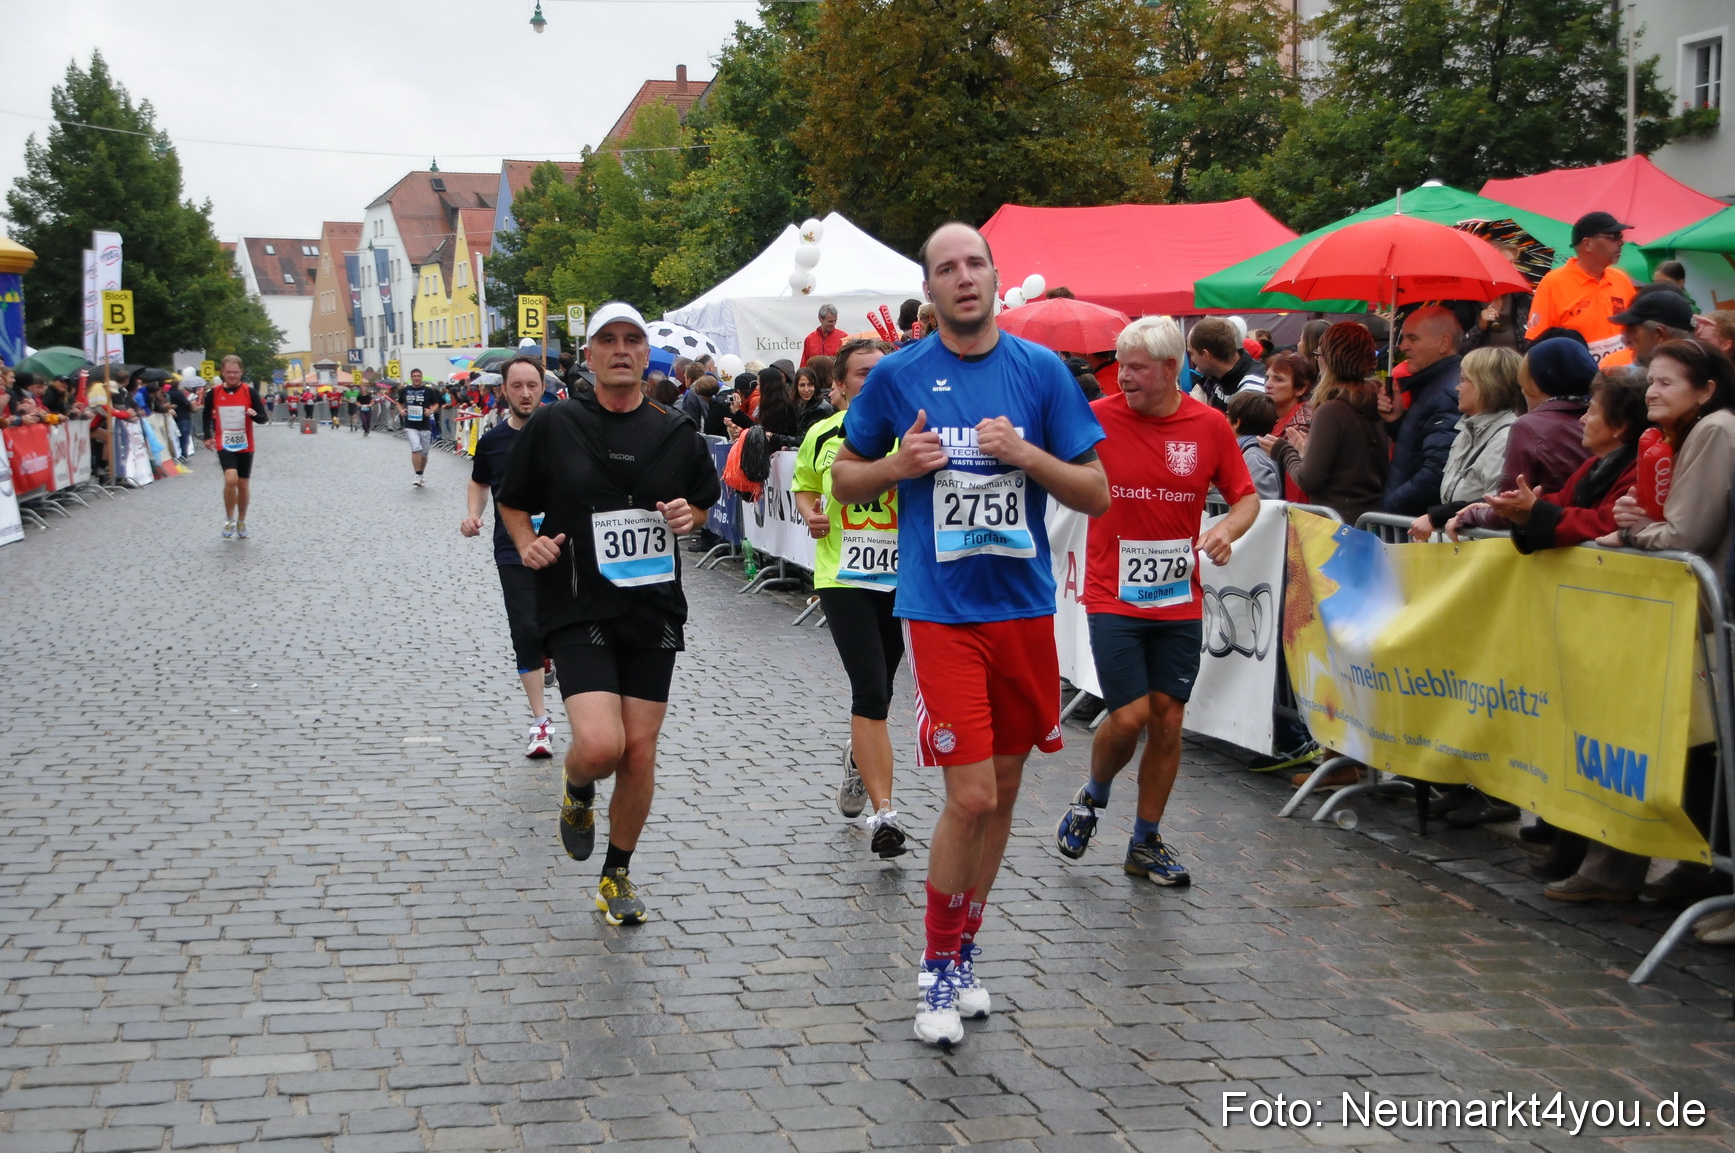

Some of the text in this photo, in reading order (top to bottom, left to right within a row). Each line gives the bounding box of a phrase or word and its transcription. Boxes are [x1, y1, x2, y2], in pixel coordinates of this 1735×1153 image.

[105, 292, 130, 301] Block
[522, 297, 544, 305] Block
[110, 304, 126, 324] B
[526, 308, 540, 328] B
[756, 337, 802, 350] Kinder
[204, 366, 212, 376] C
[391, 365, 398, 375] C
[936, 479, 1012, 490] PARTL Neumarkt
[1111, 485, 1196, 503] Stadt-Team
[944, 492, 1019, 526] 2758
[594, 518, 660, 528] PARTL Neumarkt
[603, 527, 667, 559] 3073
[963, 532, 1007, 546] Florian
[1121, 547, 1181, 555] PARTL Neumarkt
[846, 546, 898, 572] 2046
[1127, 557, 1188, 583] 2378
[1138, 587, 1174, 600] Stephan
[1573, 731, 1648, 802] KANN
